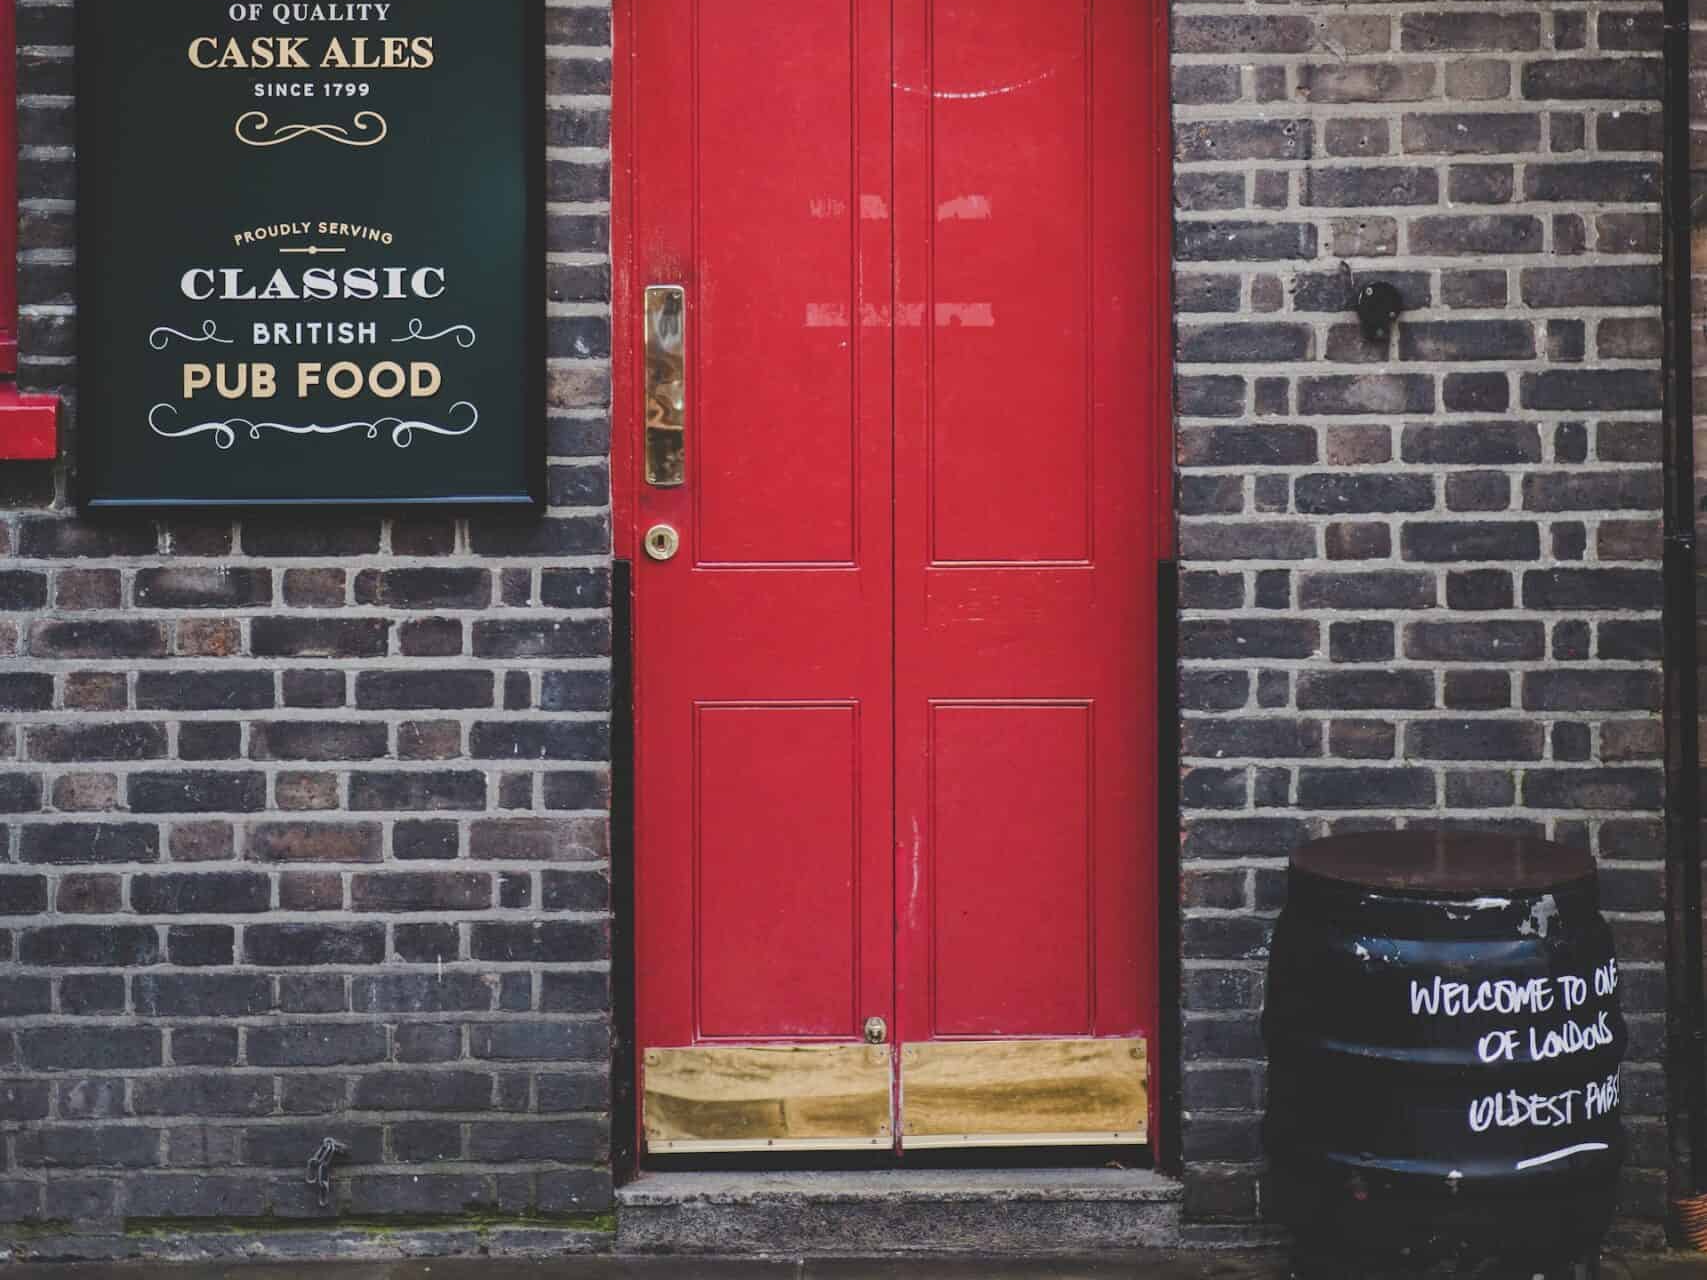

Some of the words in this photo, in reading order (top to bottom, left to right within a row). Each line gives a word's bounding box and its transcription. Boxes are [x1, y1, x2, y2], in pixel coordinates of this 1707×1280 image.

[228, 3, 264, 22] OF
[272, 3, 391, 25] QUALITY
[187, 36, 311, 70] CASK
[319, 36, 435, 70] ALES
[253, 83, 315, 98] SINCE
[323, 83, 371, 98] 1799
[233, 221, 311, 247] PROUDLY
[318, 221, 394, 246] SERVING
[180, 266, 446, 301] CLASSIC
[252, 321, 377, 346] BRITISH
[182, 362, 277, 399] PUB
[297, 360, 442, 399] FOOD
[1410, 975, 1554, 1017] WELCOME
[1556, 975, 1587, 1011] TO
[1478, 1029, 1521, 1063] OF
[1468, 1088, 1582, 1133] OLDEST
